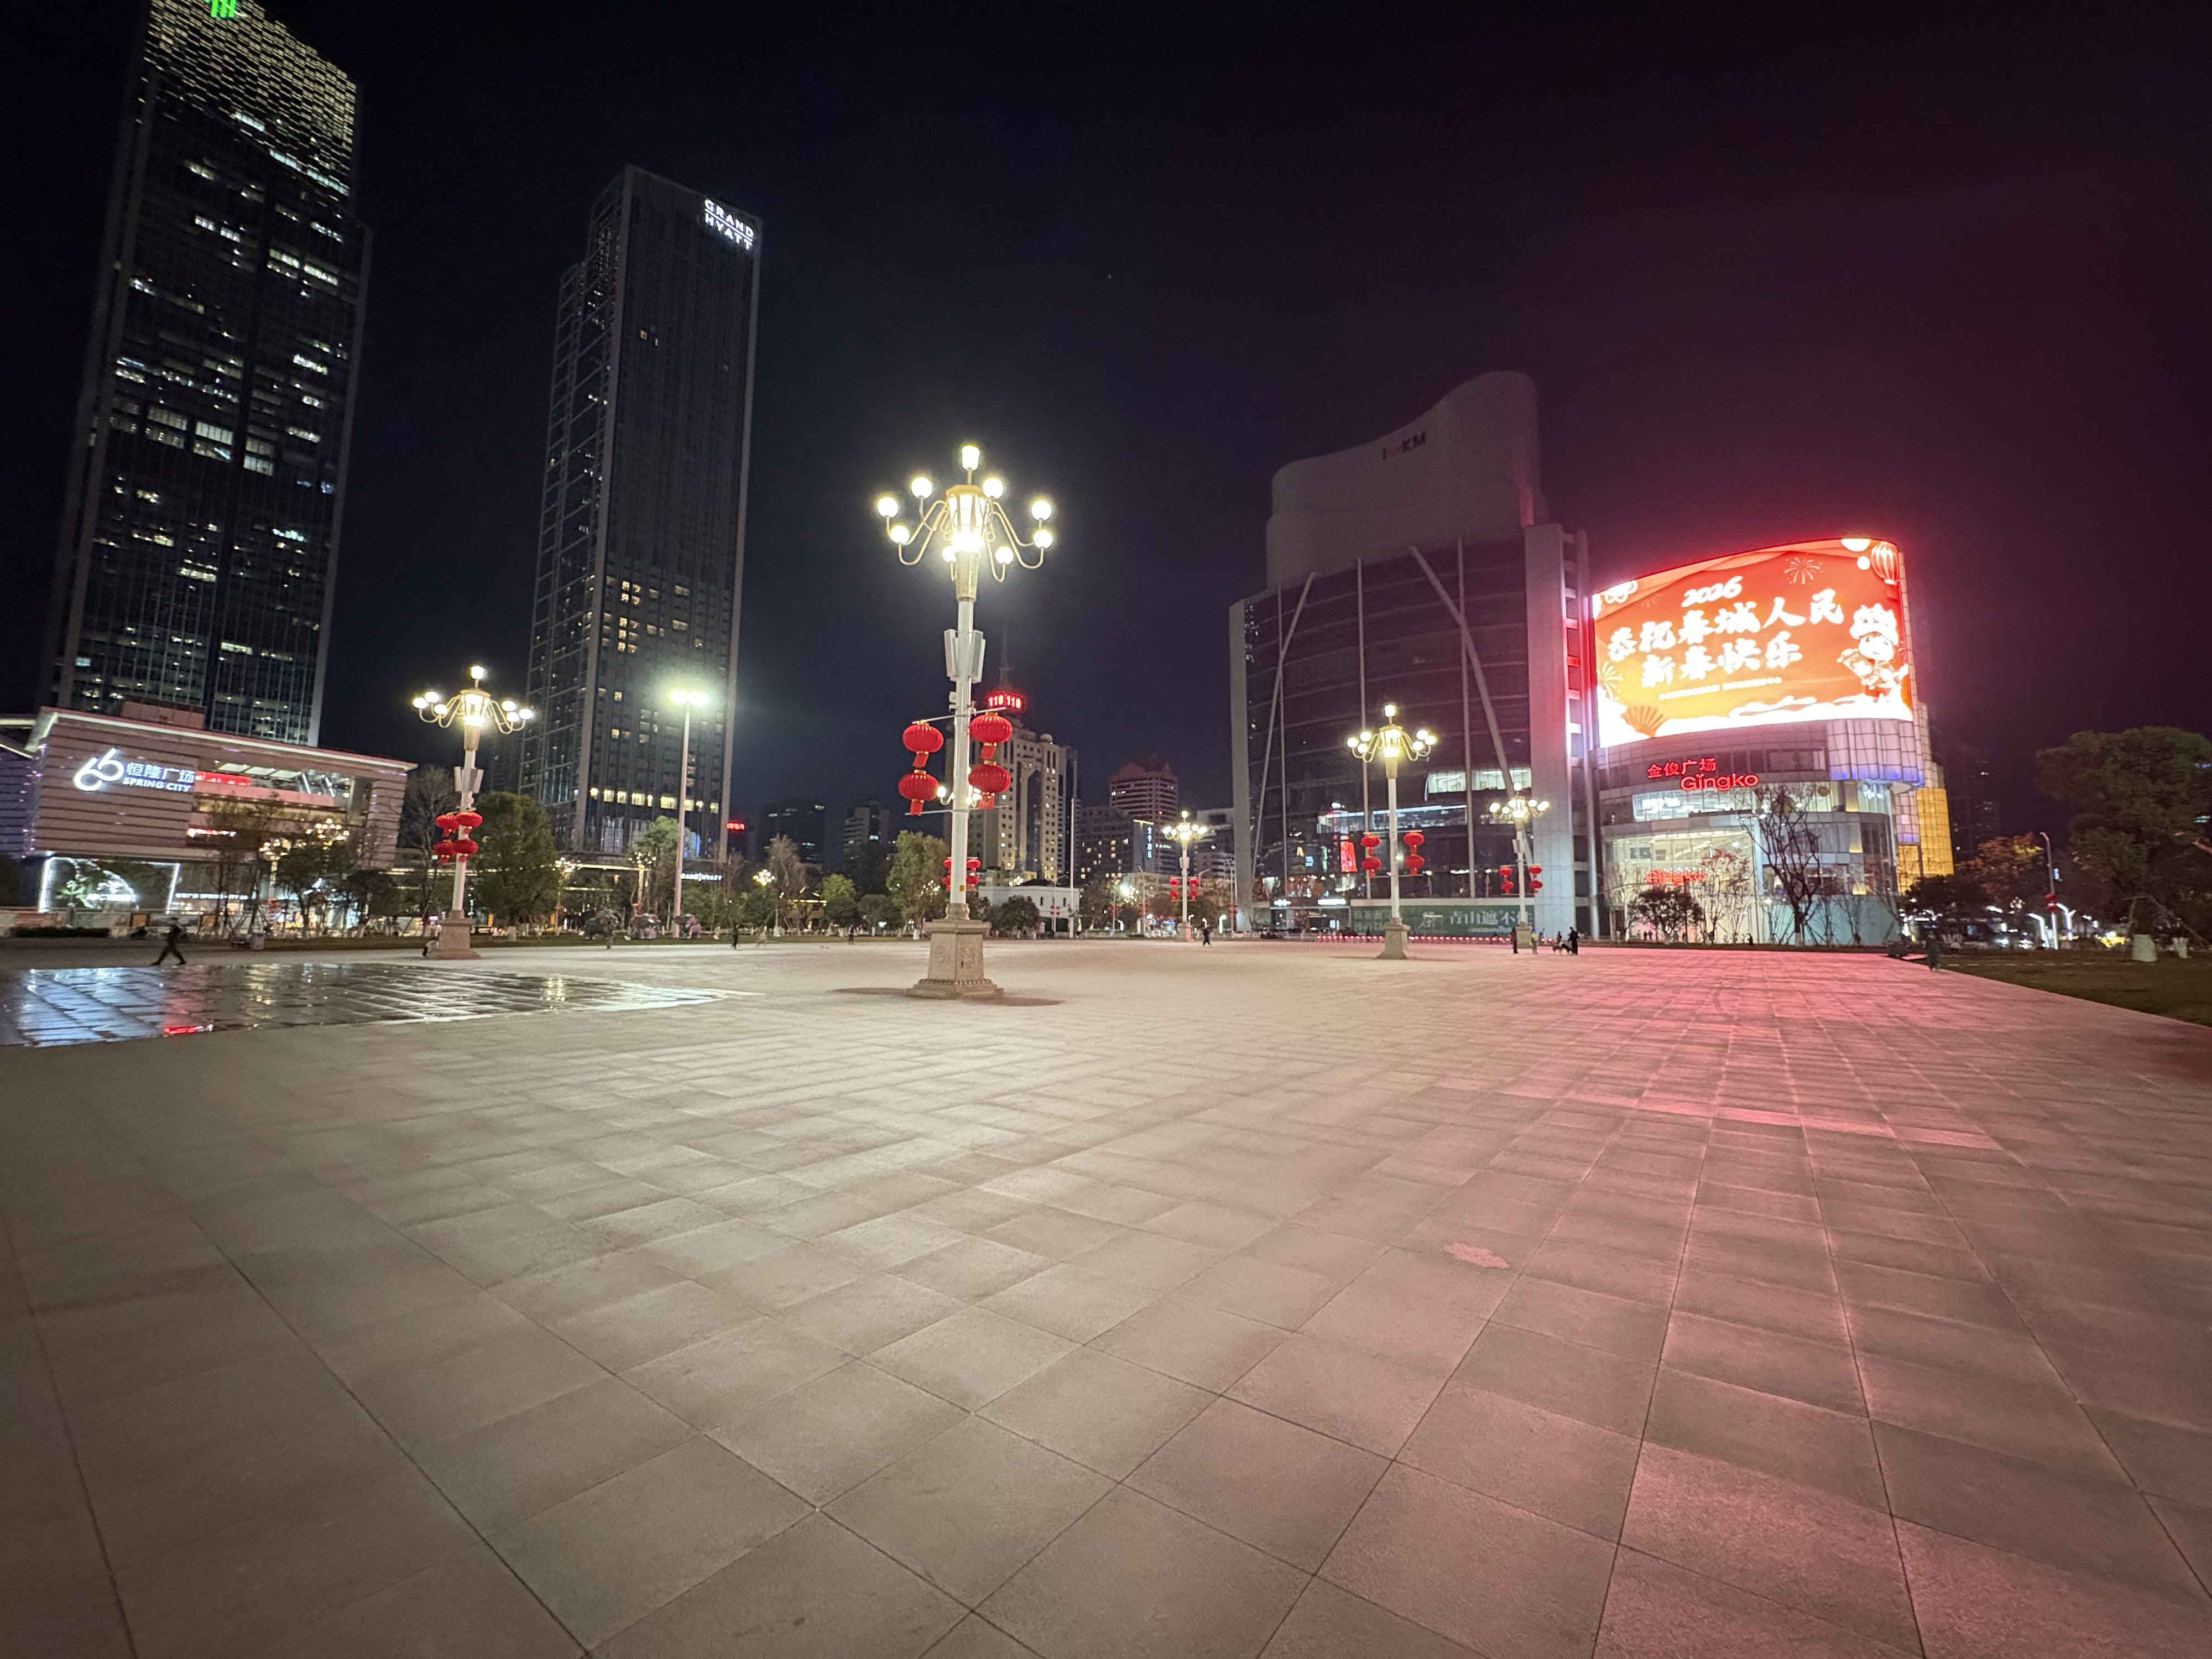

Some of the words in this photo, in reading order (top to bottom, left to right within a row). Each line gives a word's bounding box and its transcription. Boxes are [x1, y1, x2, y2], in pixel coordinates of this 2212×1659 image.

[704, 198, 755, 237] GRAND
[705, 213, 753, 251] HYATT
[1681, 576, 1743, 607] 2026
[1608, 588, 1844, 662] 恭祝春城人民
[1641, 631, 1803, 687] 新春快乐
[988, 694, 1004, 707] 110
[1006, 695, 1022, 709] 110
[74, 747, 125, 792] 66
[126, 761, 196, 784] 恒隆广场
[1647, 758, 1717, 779] 金俊广场
[1679, 773, 1760, 792] Gingko
[122, 776, 164, 790] SPRING
[166, 781, 192, 793] CITY
